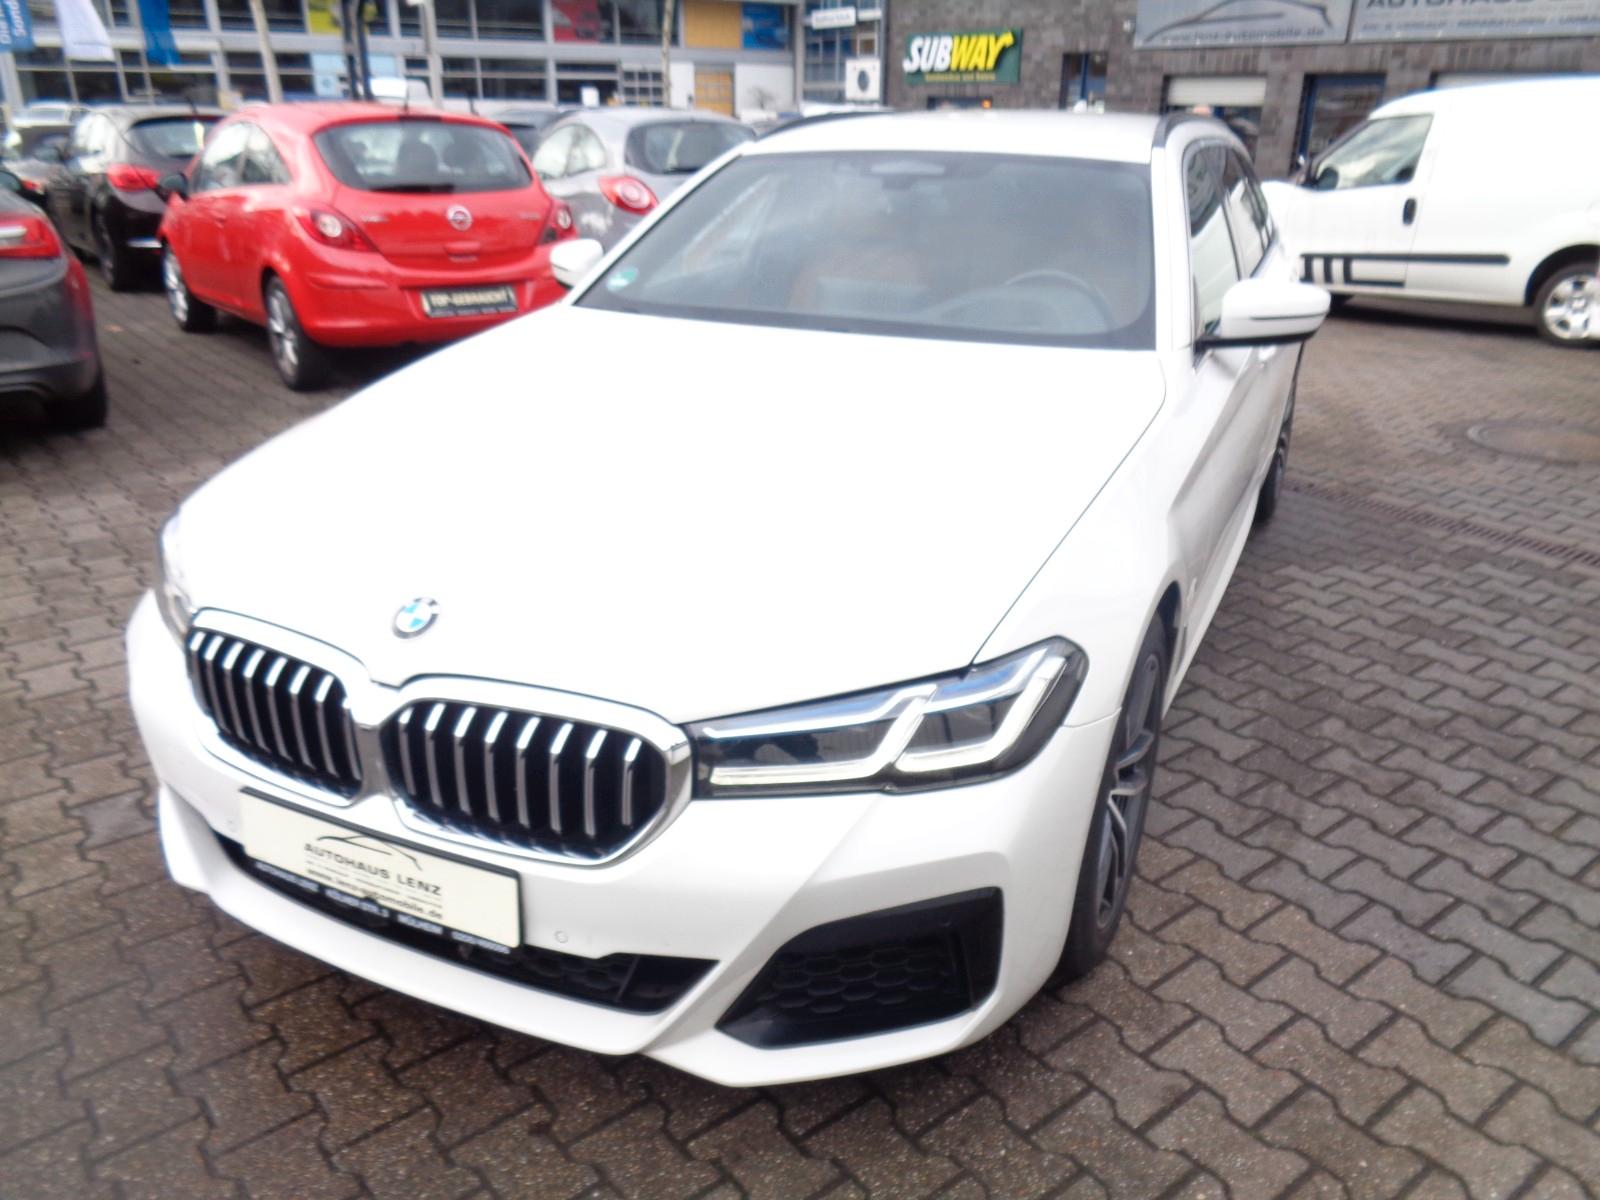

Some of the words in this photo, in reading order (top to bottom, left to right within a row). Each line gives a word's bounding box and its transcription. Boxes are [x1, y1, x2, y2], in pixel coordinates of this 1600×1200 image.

[902, 30, 1014, 73] SUBWAY
[304, 843, 390, 879] AUTOHAUS
[397, 873, 442, 896] LENZ
